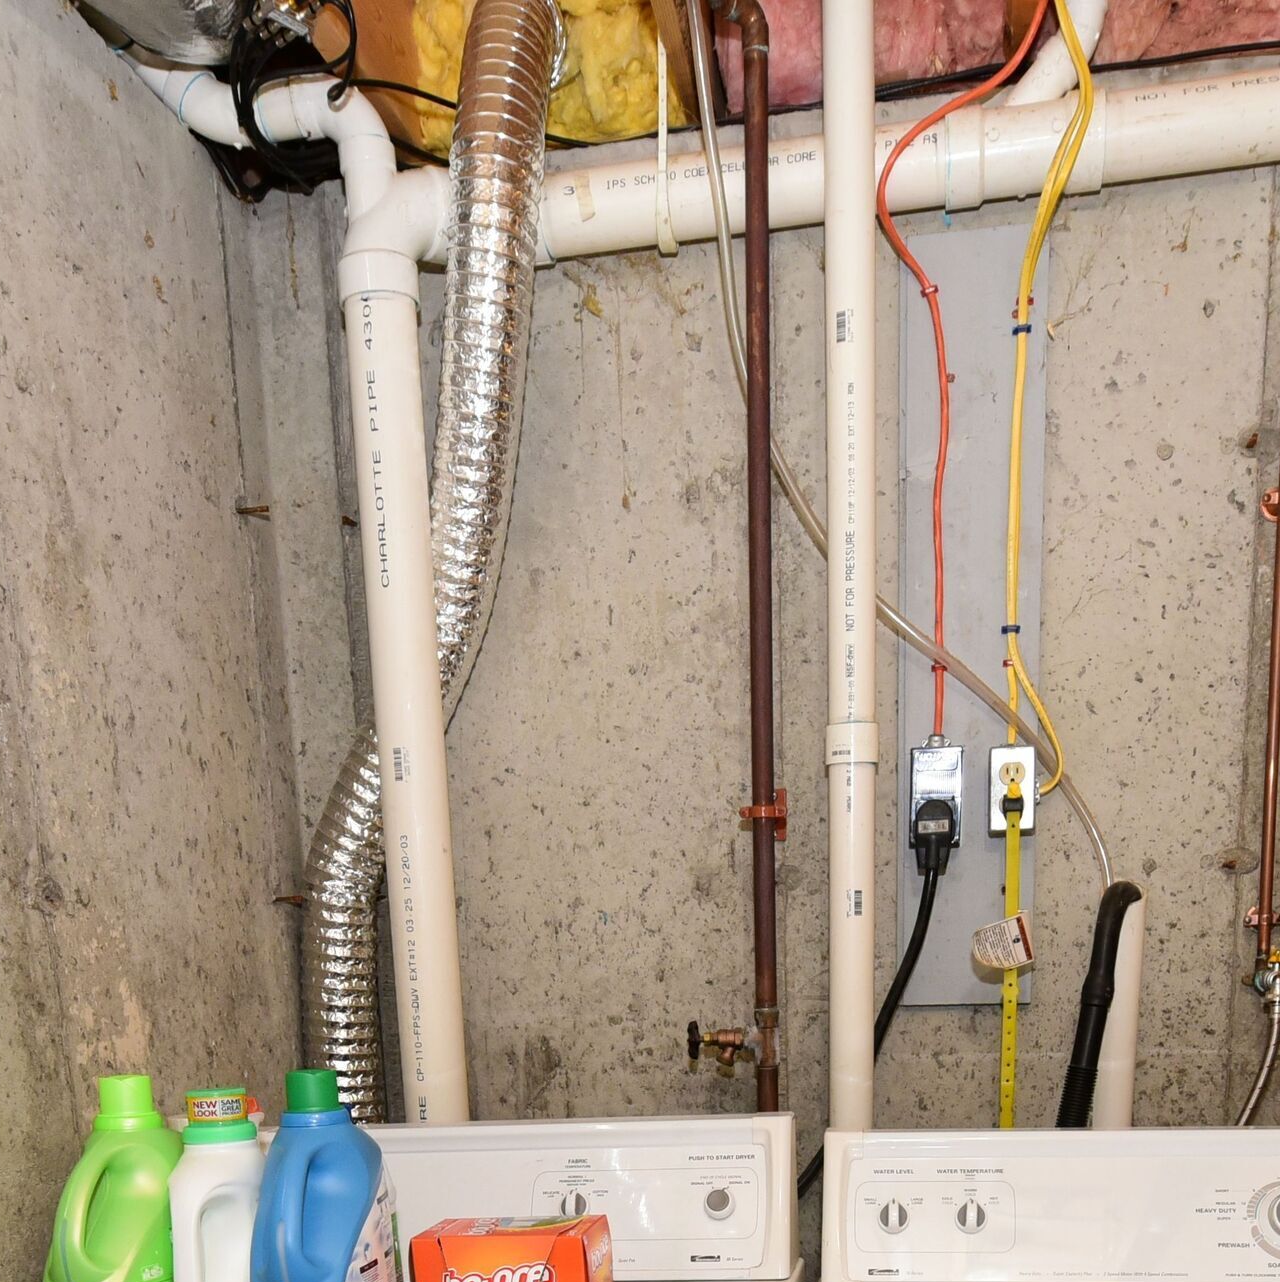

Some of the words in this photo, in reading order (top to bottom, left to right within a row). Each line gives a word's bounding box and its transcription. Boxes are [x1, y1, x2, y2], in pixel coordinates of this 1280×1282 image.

[1134, 92, 1168, 103] NOT
[1183, 84, 1220, 96] FOR
[606, 178, 627, 190] IPS
[634, 174, 656, 186] SCH
[683, 165, 710, 180] COE
[786, 150, 817, 165] CORE
[366, 368, 379, 432] PIPE
[371, 449, 389, 589] CHARLOTTE
[845, 530, 855, 582] PRESSURE
[845, 586, 855, 608] FOR
[845, 613, 855, 632] NOT
[400, 833, 412, 891] 12/20/03
[193, 1100, 218, 1109] NEW
[419, 1095, 427, 1123] RE
